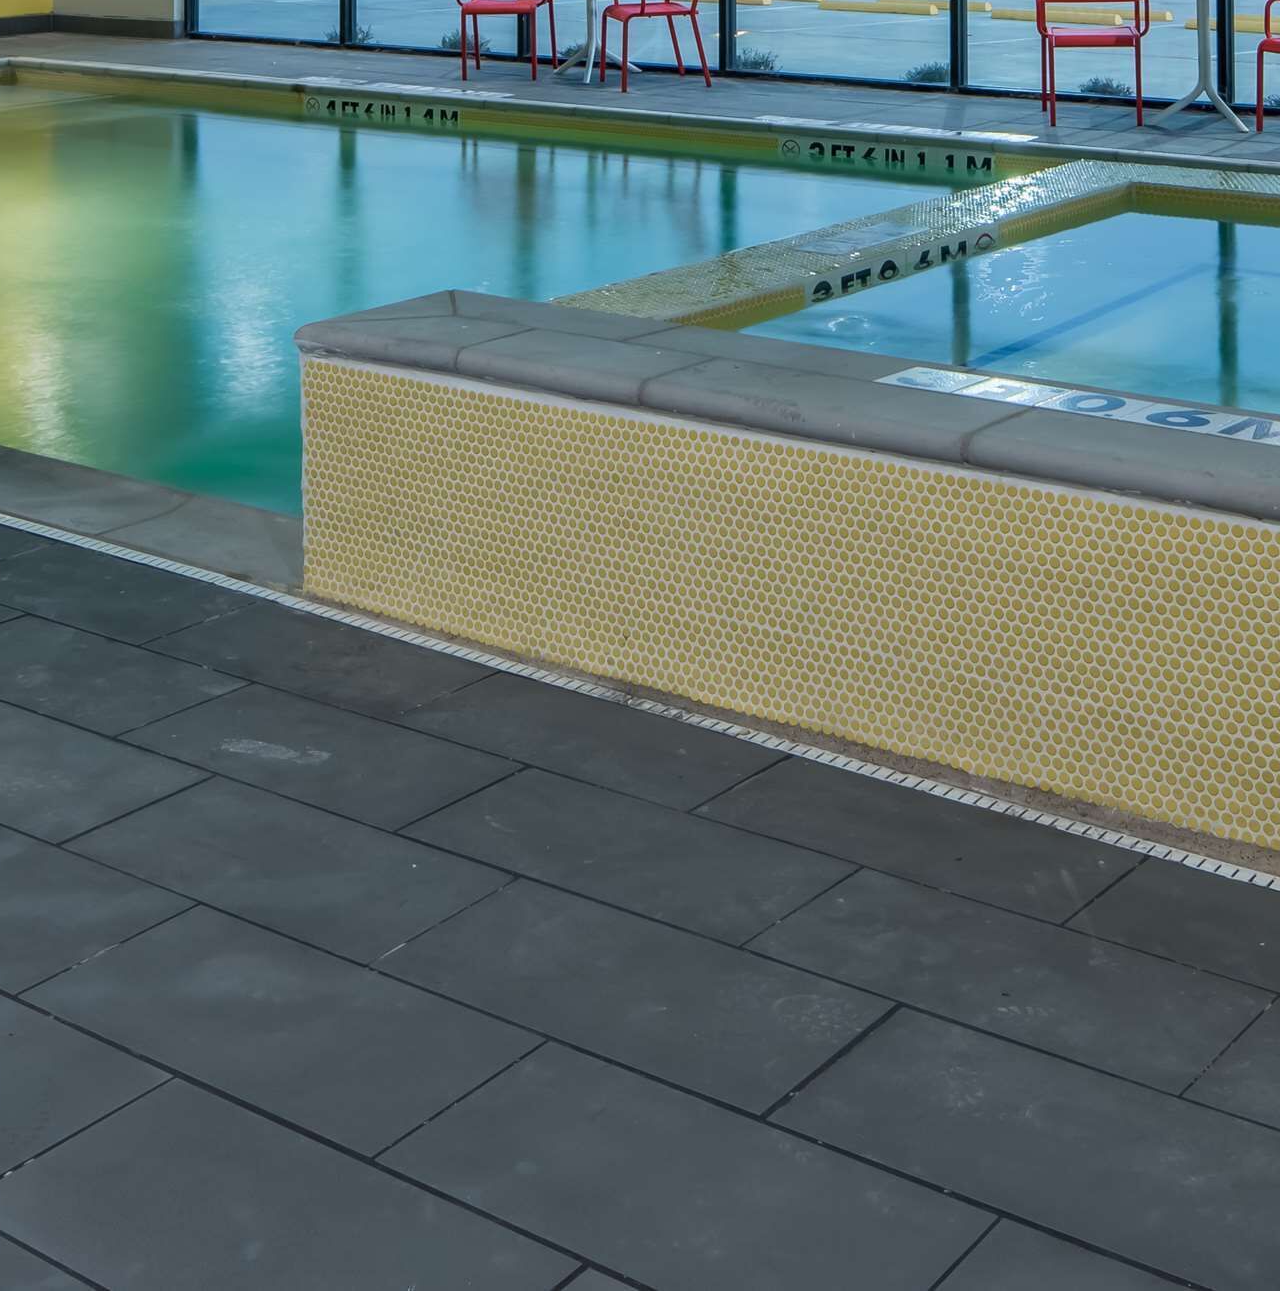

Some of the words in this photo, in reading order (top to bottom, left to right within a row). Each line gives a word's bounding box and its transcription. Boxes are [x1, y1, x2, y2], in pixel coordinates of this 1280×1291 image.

[381, 104, 396, 117] IN
[440, 110, 459, 122] M
[885, 149, 905, 163] IN
[966, 156, 992, 171] M
[841, 268, 871, 294] FT
[941, 241, 967, 263] M
